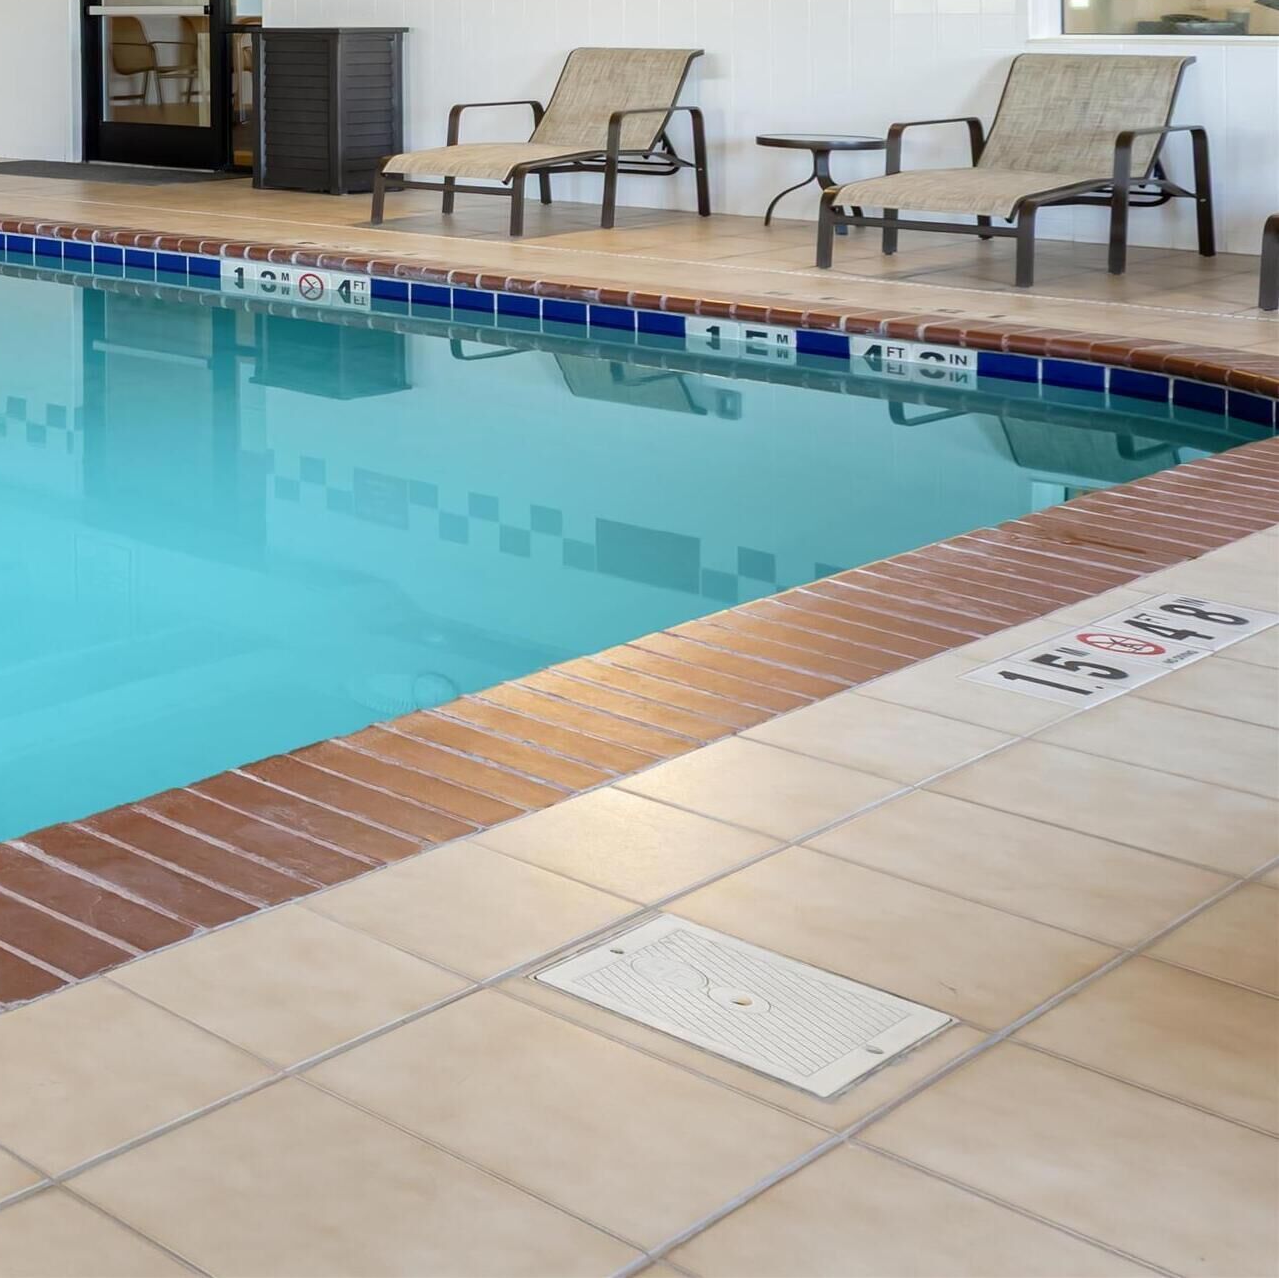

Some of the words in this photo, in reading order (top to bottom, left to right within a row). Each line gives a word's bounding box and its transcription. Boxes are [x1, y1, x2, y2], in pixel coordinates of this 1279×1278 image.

[354, 280, 366, 290] FT
[777, 334, 788, 344] M
[887, 346, 905, 358] FT
[949, 353, 967, 366] IN
[1159, 604, 1250, 625] 8
[1123, 619, 1215, 640] 4
[998, 654, 1130, 695] 1.5
